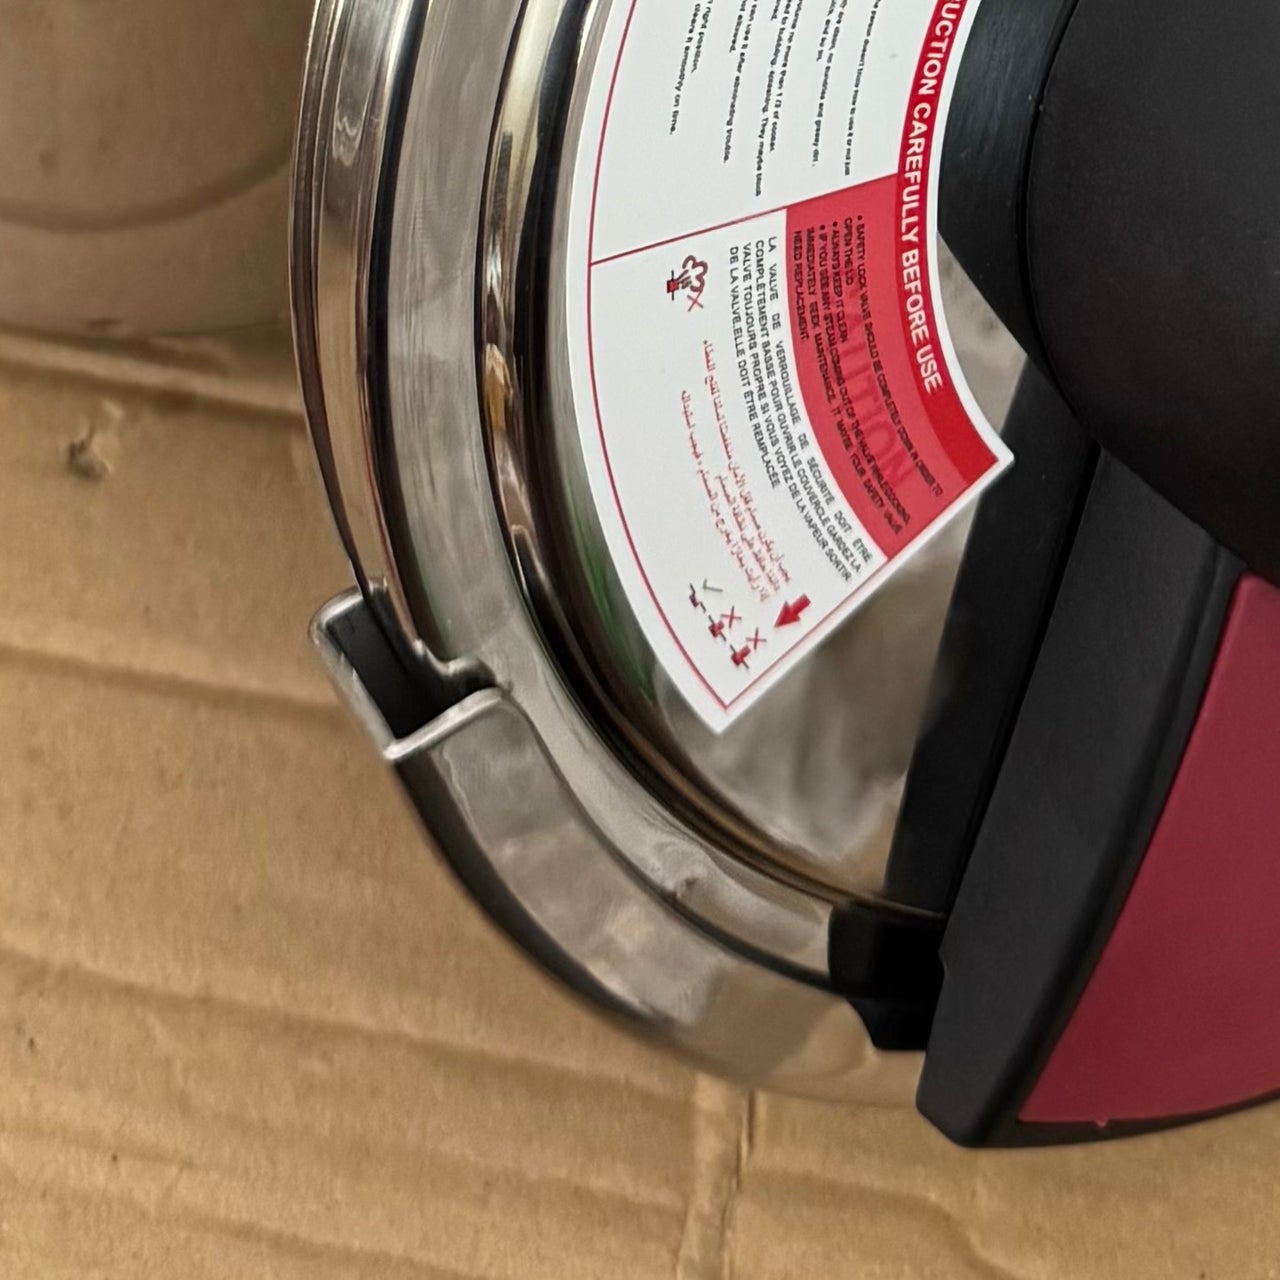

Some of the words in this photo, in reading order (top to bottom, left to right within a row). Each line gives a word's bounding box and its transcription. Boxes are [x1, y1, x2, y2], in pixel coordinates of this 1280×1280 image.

[898, 102, 933, 247] CAREFULLY
[728, 244, 739, 266] DE
[740, 241, 752, 283] VALVE
[765, 234, 778, 254] LA
[728, 266, 740, 285] LA
[766, 262, 780, 303] VALVE
[898, 247, 930, 346] BEFORE
[741, 283, 758, 352] TOUJOURS
[769, 311, 783, 332] DE
[735, 357, 751, 390] DOIT
[747, 350, 768, 402] PROPRE
[759, 339, 777, 380] BASSE
[912, 343, 943, 394] USE
[758, 400, 771, 416] SI
[766, 378, 785, 413] POUR
[761, 413, 781, 449] VOUS
[775, 410, 798, 455] OUVRIR
[794, 430, 811, 452] DE
[771, 445, 795, 485] VOYEZ
[788, 451, 803, 470] LE
[785, 480, 802, 501] DE
[793, 496, 809, 515] LA
[794, 466, 832, 528] COUVERCLE
[800, 509, 831, 552] VAPEUR
[831, 508, 854, 536] DOIT
[823, 522, 855, 563] GARDEZ
[822, 546, 854, 583] SORTIR
[846, 557, 863, 575] LA
